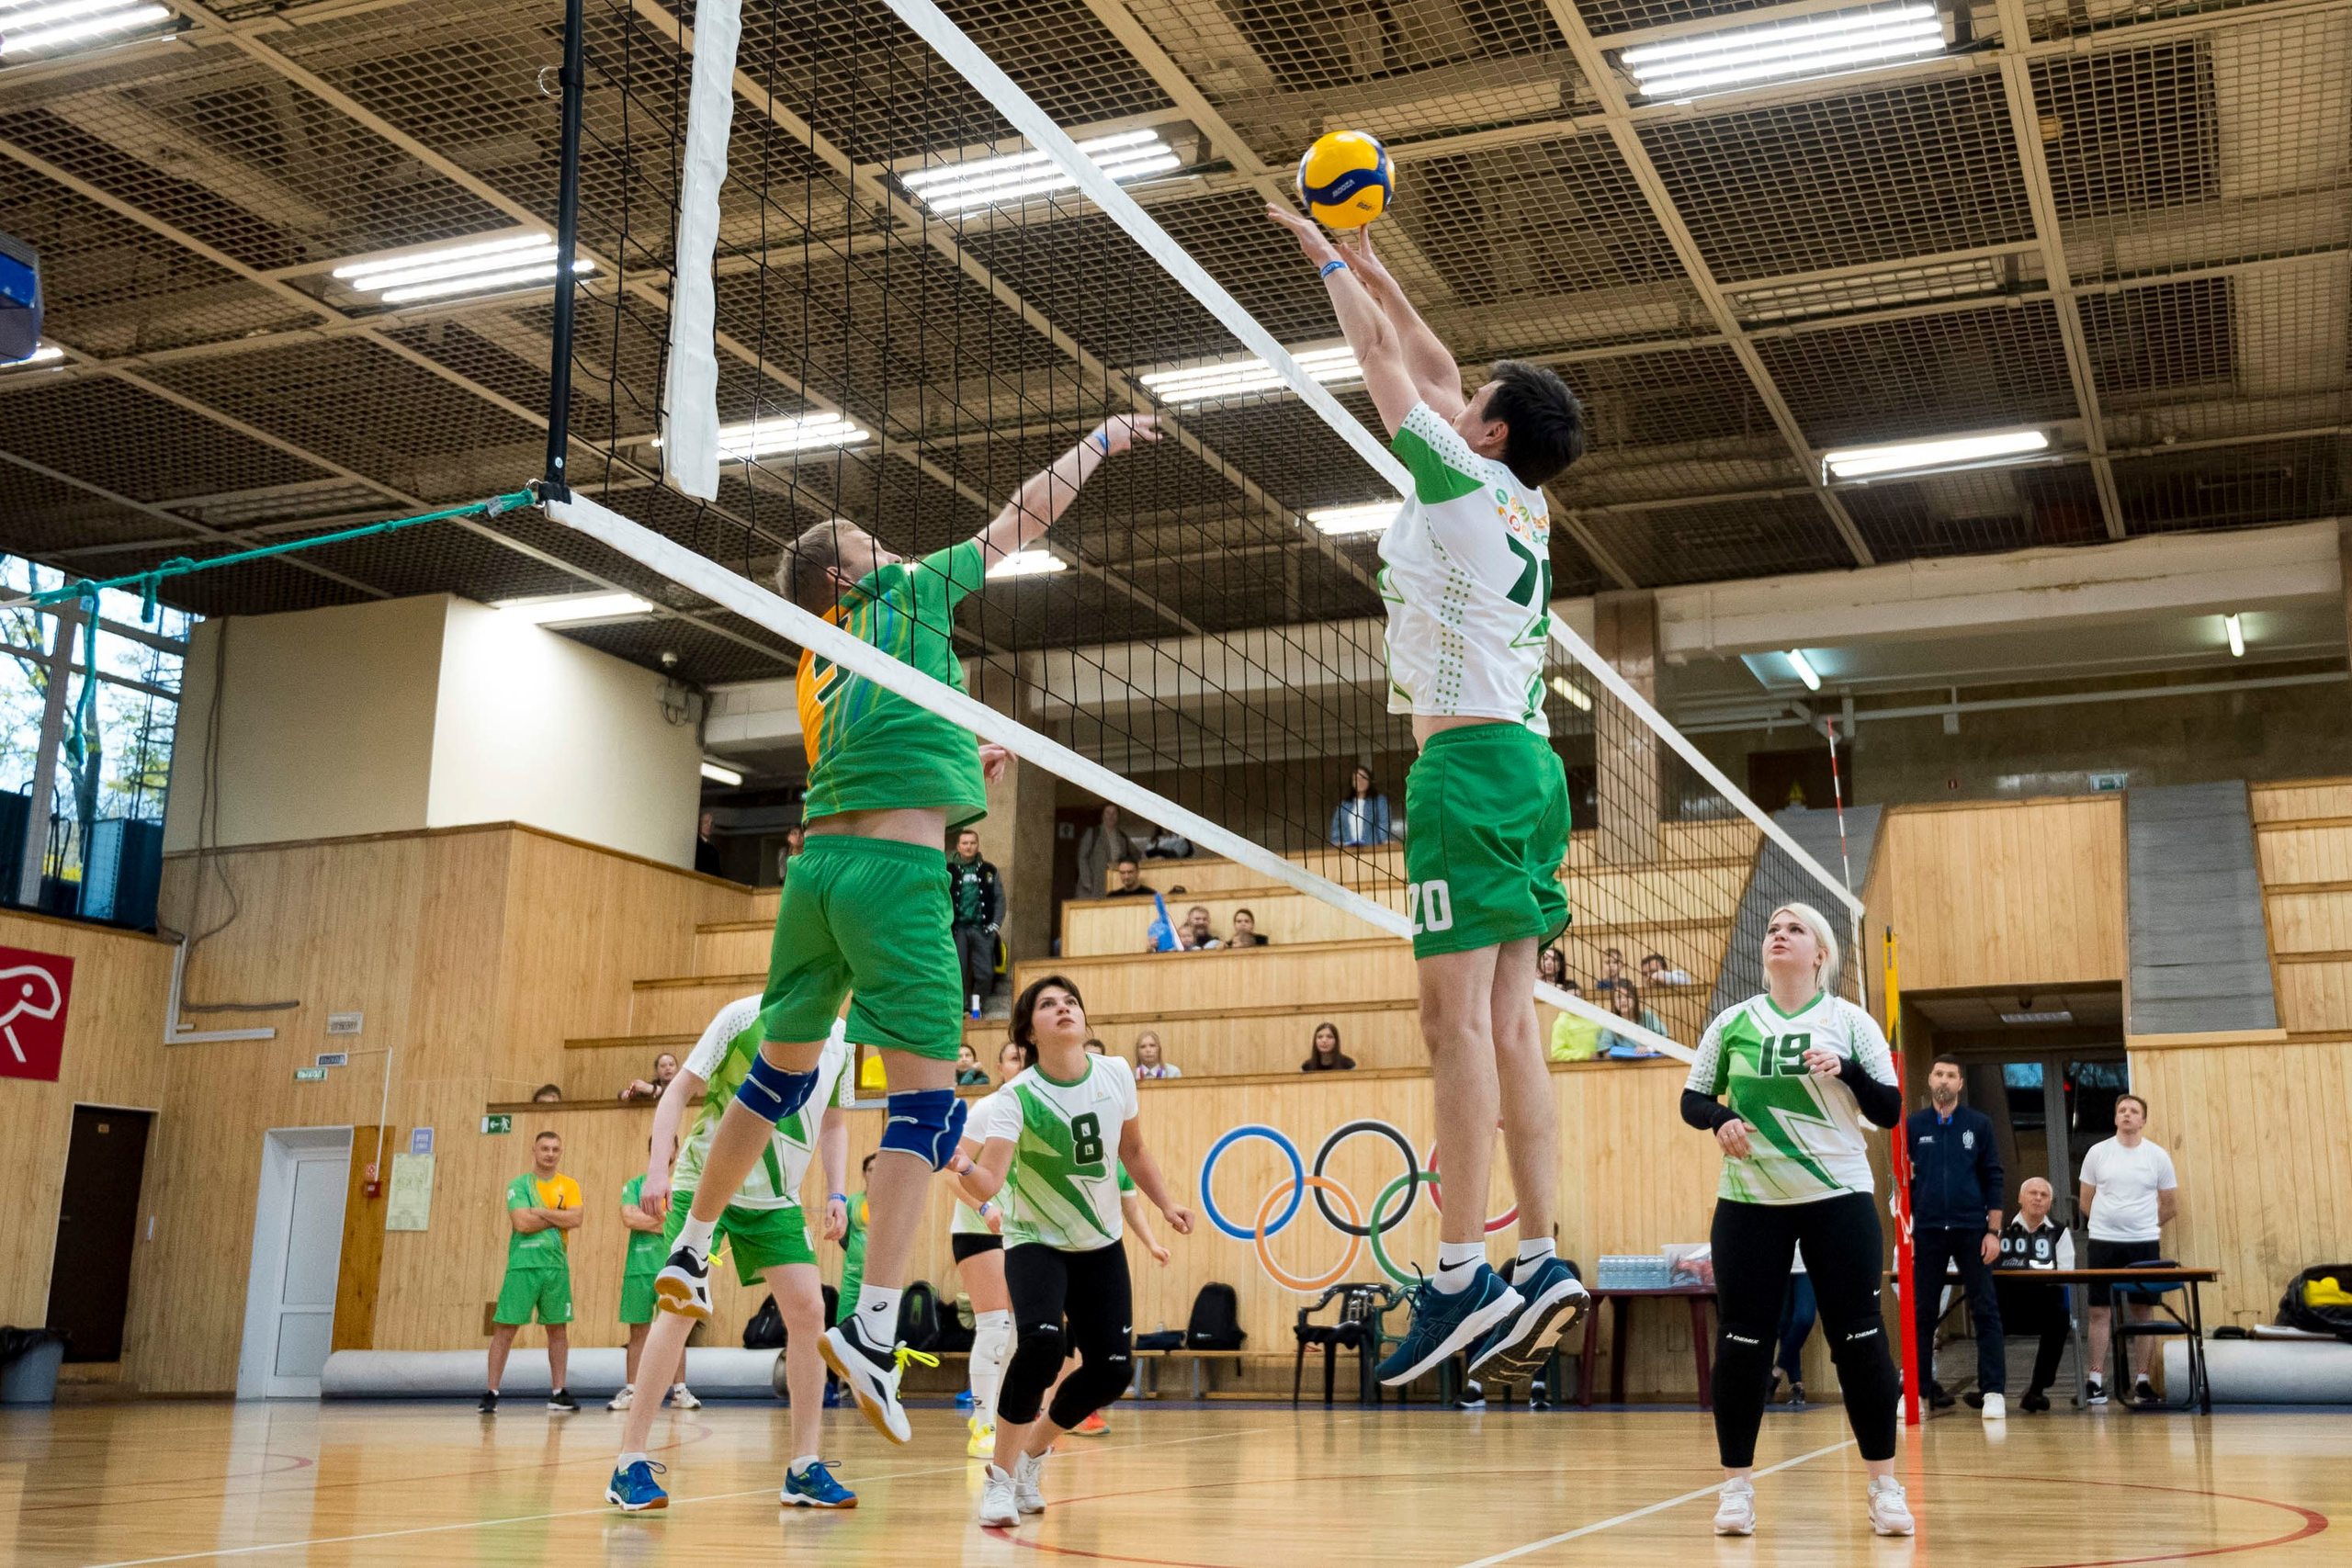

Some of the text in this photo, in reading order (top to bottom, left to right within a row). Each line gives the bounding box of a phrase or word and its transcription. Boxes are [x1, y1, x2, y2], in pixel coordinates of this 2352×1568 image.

[1758, 1032, 1812, 1077] 19
[1070, 1111, 1104, 1166] 8
[2034, 1237, 2050, 1259] 9
[1733, 1336, 1760, 1345] DEMIX
[1854, 1327, 1878, 1339] DEMIX
